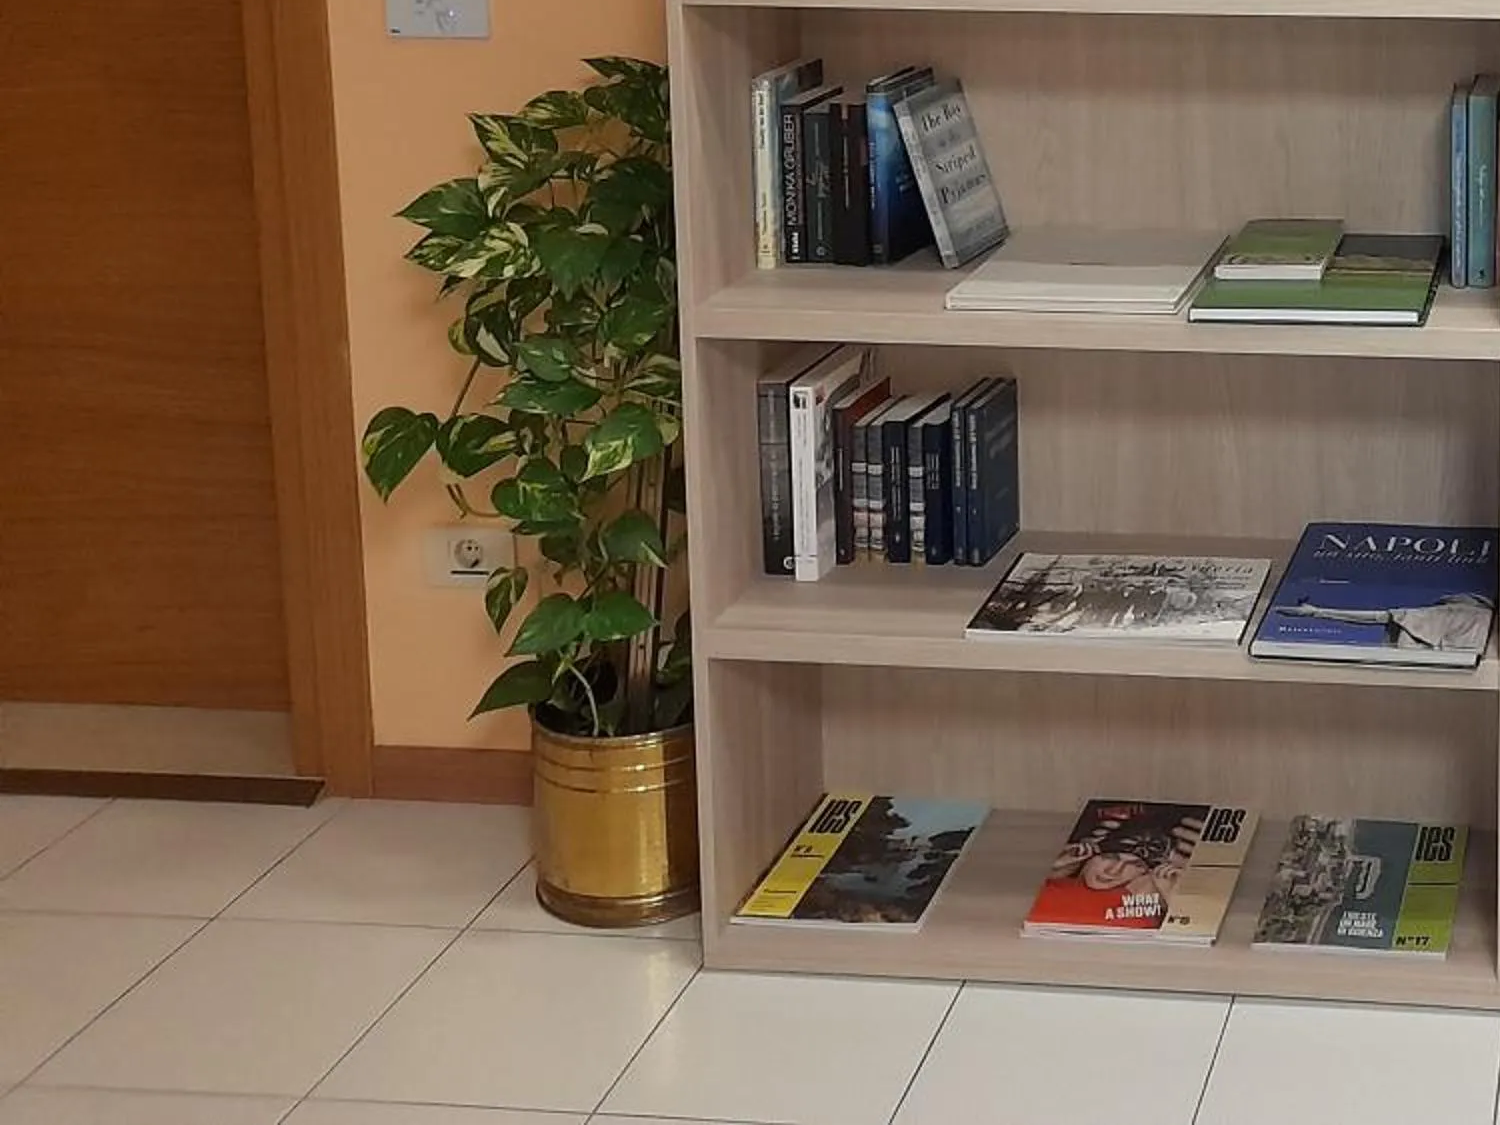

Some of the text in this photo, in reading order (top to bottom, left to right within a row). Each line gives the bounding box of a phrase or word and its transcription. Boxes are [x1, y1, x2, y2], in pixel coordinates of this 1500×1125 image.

[783, 114, 797, 226] MONIKA GRUBER
[1320, 534, 1491, 556] NAPOLI
[1121, 892, 1161, 909] WHAT
